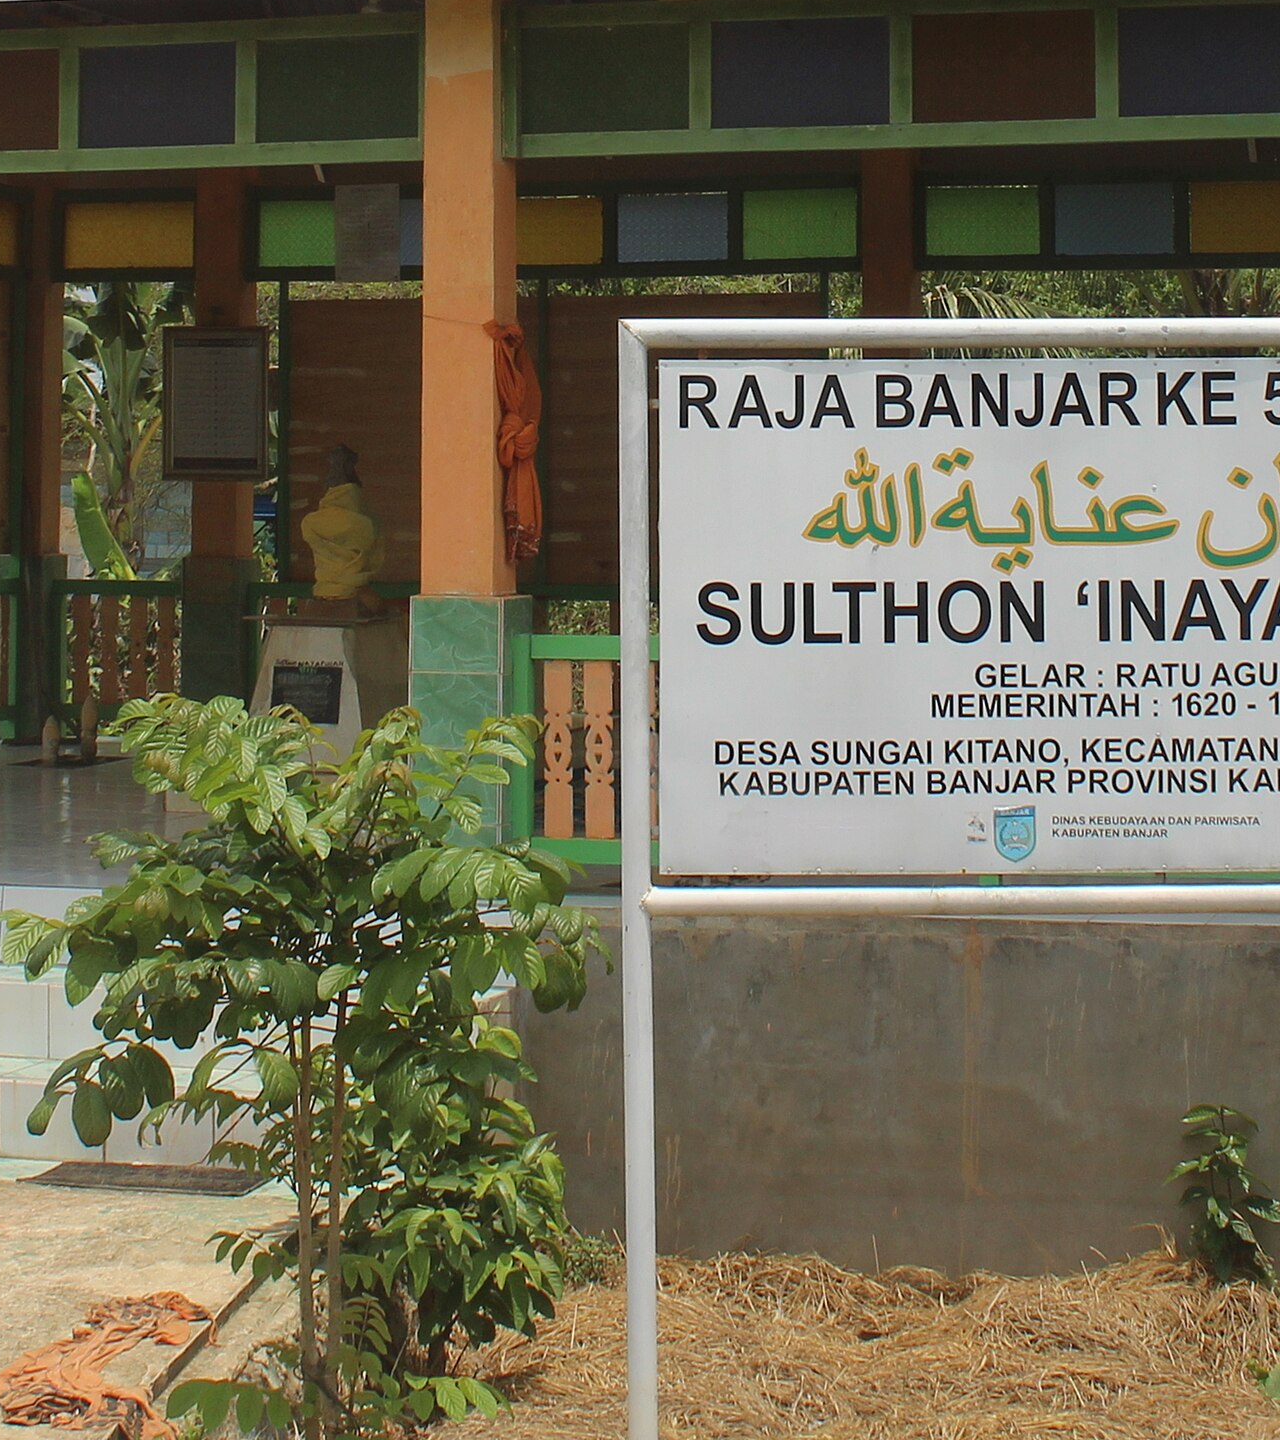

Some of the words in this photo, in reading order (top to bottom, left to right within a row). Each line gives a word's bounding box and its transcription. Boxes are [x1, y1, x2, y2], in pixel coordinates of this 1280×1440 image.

[679, 374, 856, 430] RAJA
[875, 371, 1141, 429] BANJAR
[1156, 371, 1237, 426] KE
[802, 446, 924, 551] الله
[932, 447, 1181, 575] عناية
[696, 580, 1045, 646] SULTHON
[974, 663, 1086, 688] GELAR
[1116, 663, 1201, 688] RATU
[931, 693, 1140, 718] MEMERINTAH
[1172, 692, 1237, 717] 1620
[714, 740, 802, 766] DESA
[810, 740, 932, 766] SUNGAI
[944, 738, 1069, 767] KITANO,
[1081, 737, 1279, 763] KECAMATAN
[719, 770, 914, 796] KABUPATEN
[927, 769, 1056, 795] BANJAR
[1064, 763, 1217, 794] PROVINSI
[1051, 816, 1086, 825] DINAS
[1089, 816, 1166, 825] KEBUDAYAAN
[1168, 817, 1191, 825] DAN
[1194, 817, 1260, 826] PARIWISATA
[1051, 829, 1120, 838] KABUPATEN
[1123, 829, 1168, 838] BANJAR
